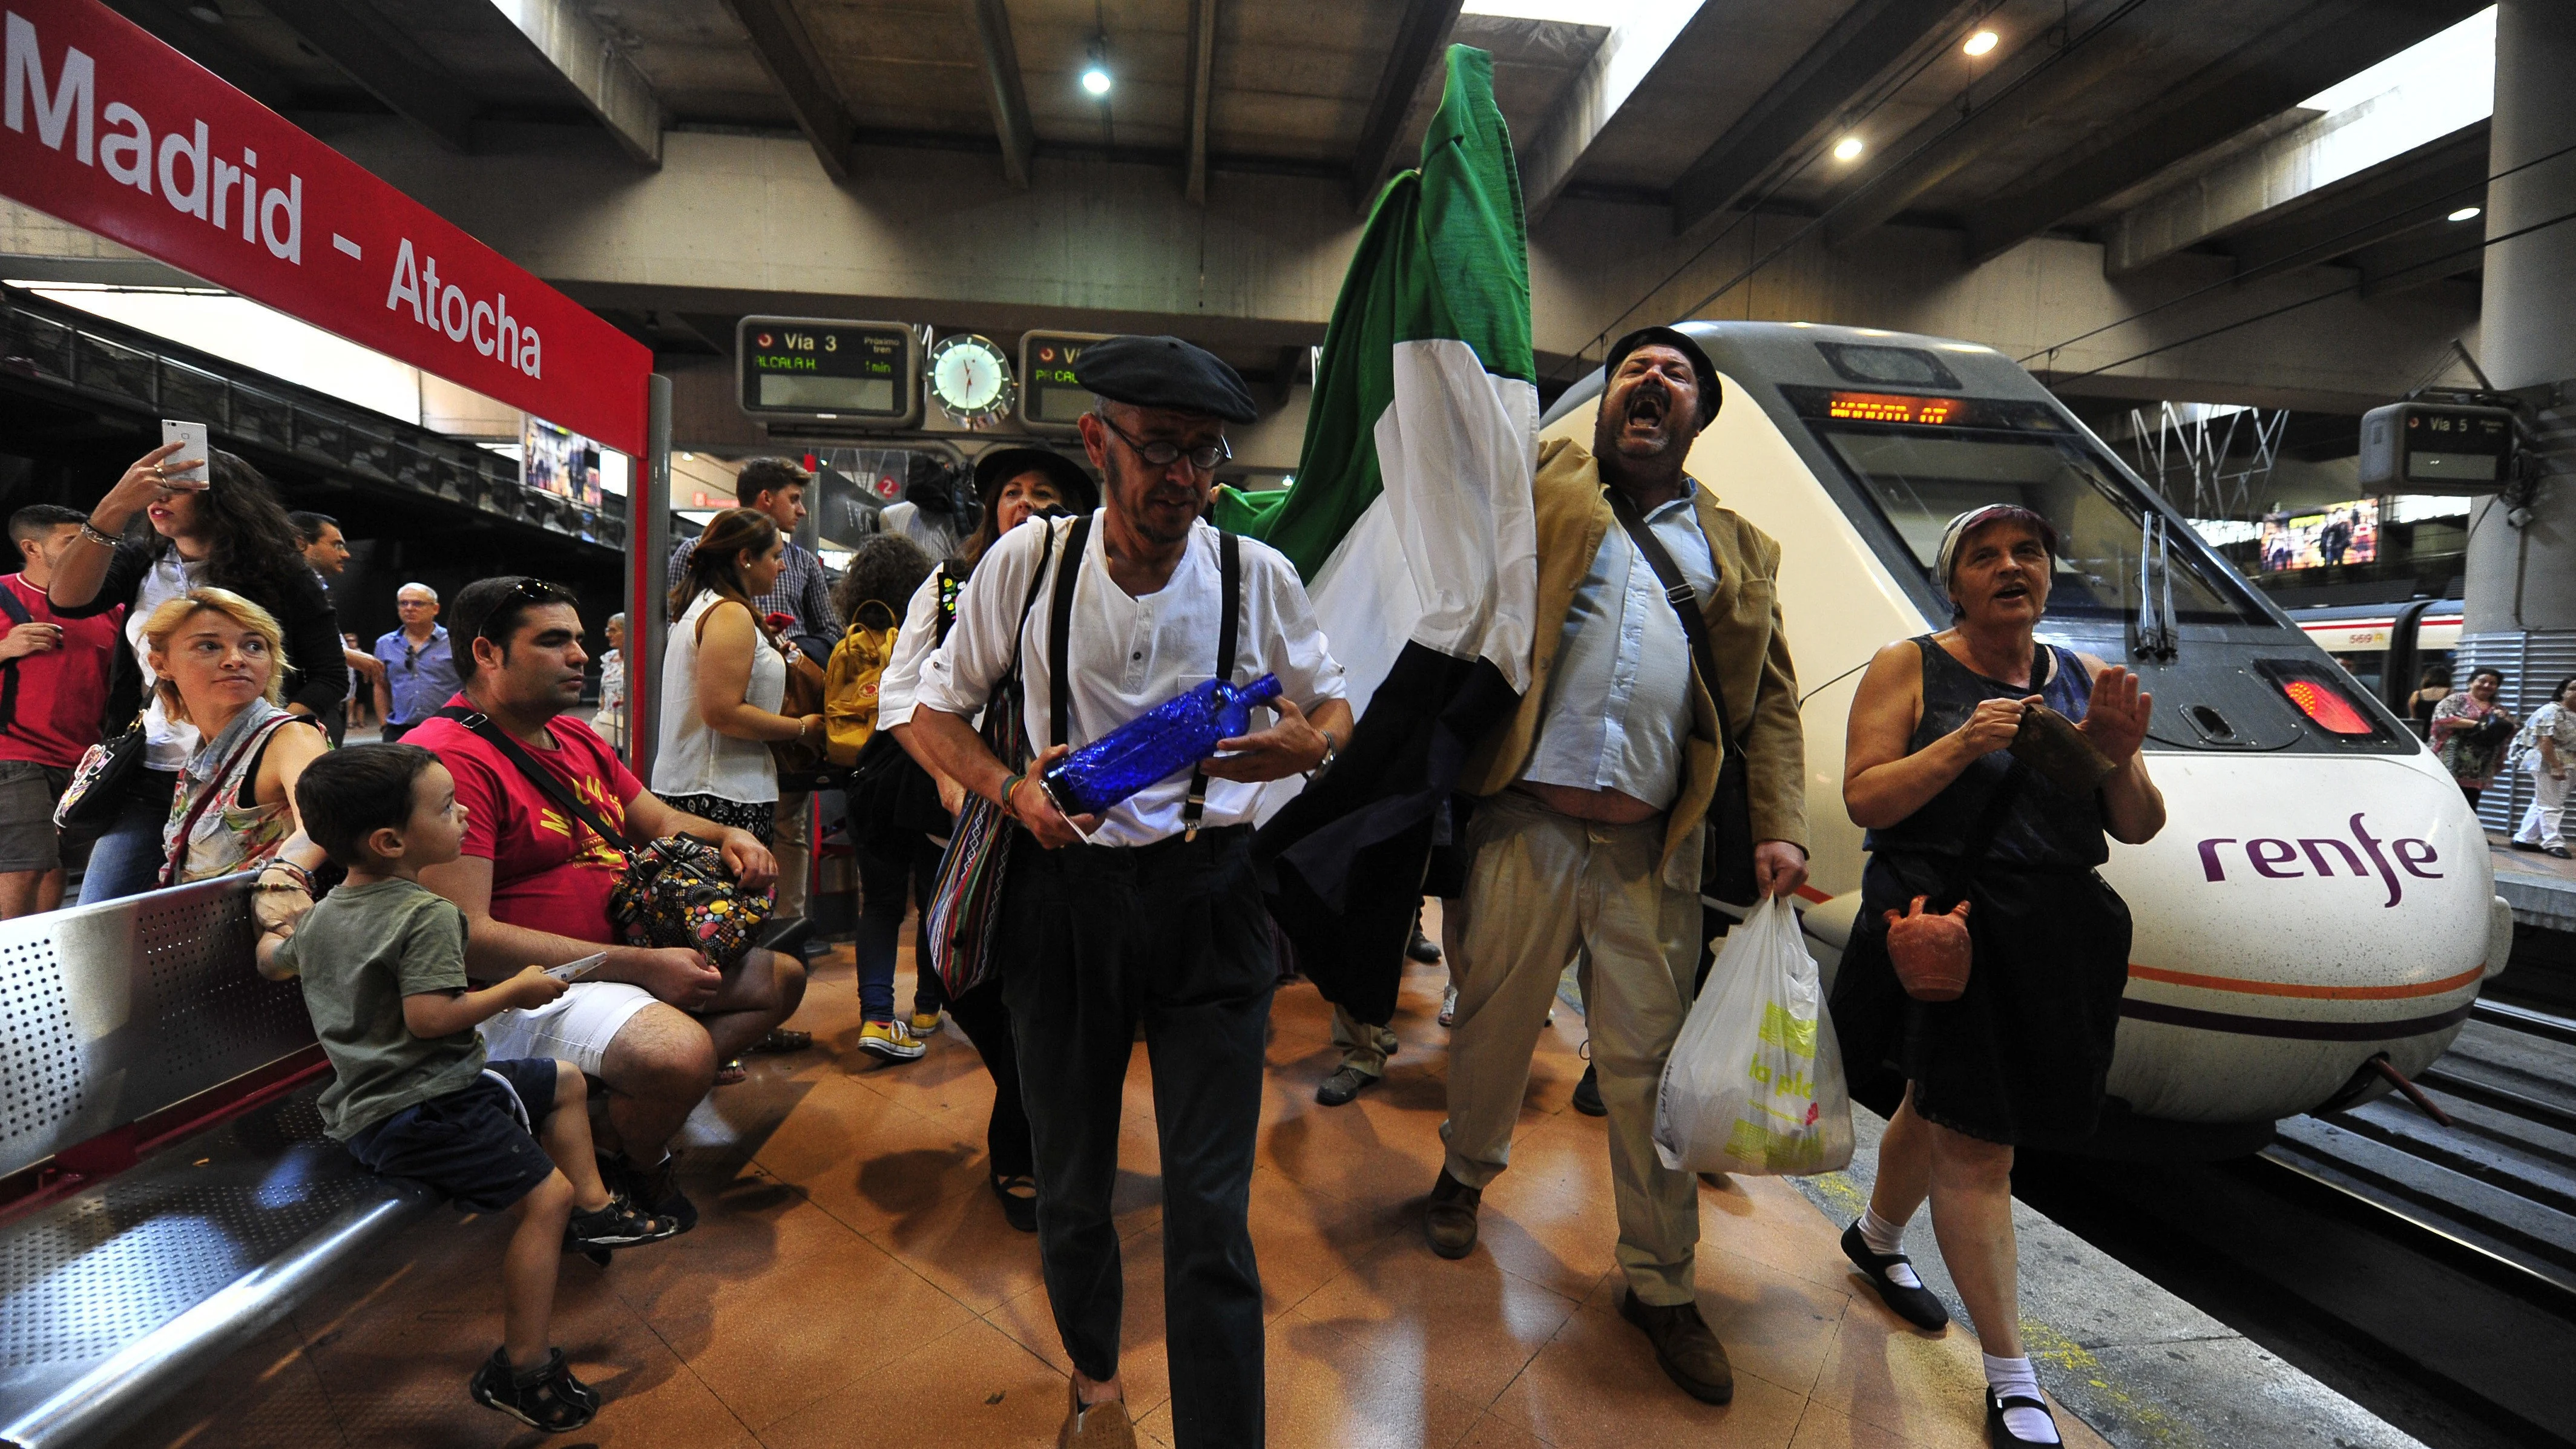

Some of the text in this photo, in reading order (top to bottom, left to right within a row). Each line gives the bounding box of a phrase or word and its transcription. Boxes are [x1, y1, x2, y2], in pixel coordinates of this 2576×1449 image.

[5, 9, 542, 381] Madrid - Atocha
[824, 335, 837, 352] 3
[2457, 418, 2468, 432] 5
[883, 479, 892, 494] 2
[2197, 812, 2444, 908] renfe
[1749, 1052, 1772, 1085] la
